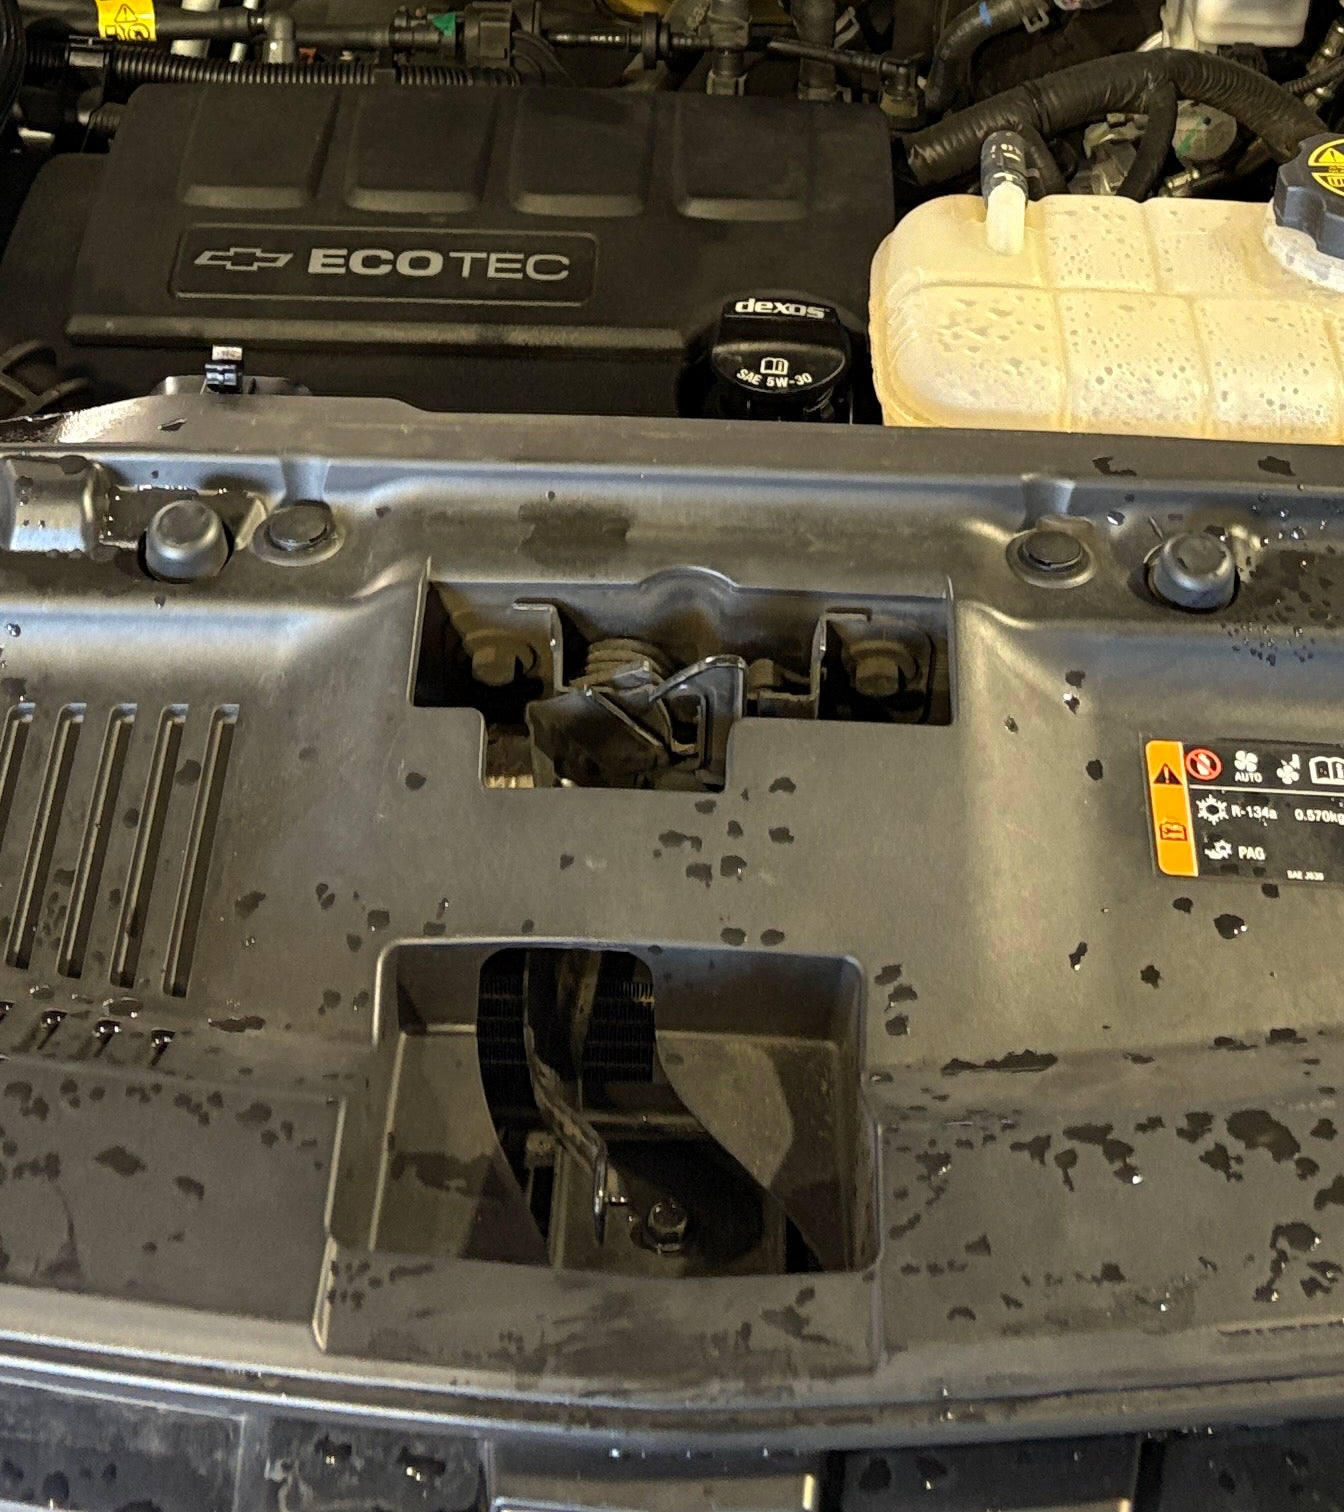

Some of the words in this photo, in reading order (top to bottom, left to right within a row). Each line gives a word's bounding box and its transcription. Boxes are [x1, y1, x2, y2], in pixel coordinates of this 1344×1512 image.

[307, 247, 570, 281] ECOTEC
[734, 298, 826, 319] dexos
[736, 368, 763, 386] SAE
[765, 372, 813, 388] 5W-30
[1234, 771, 1263, 783] AUTO
[1230, 804, 1278, 820] R-134a
[1237, 845, 1267, 861] PAG
